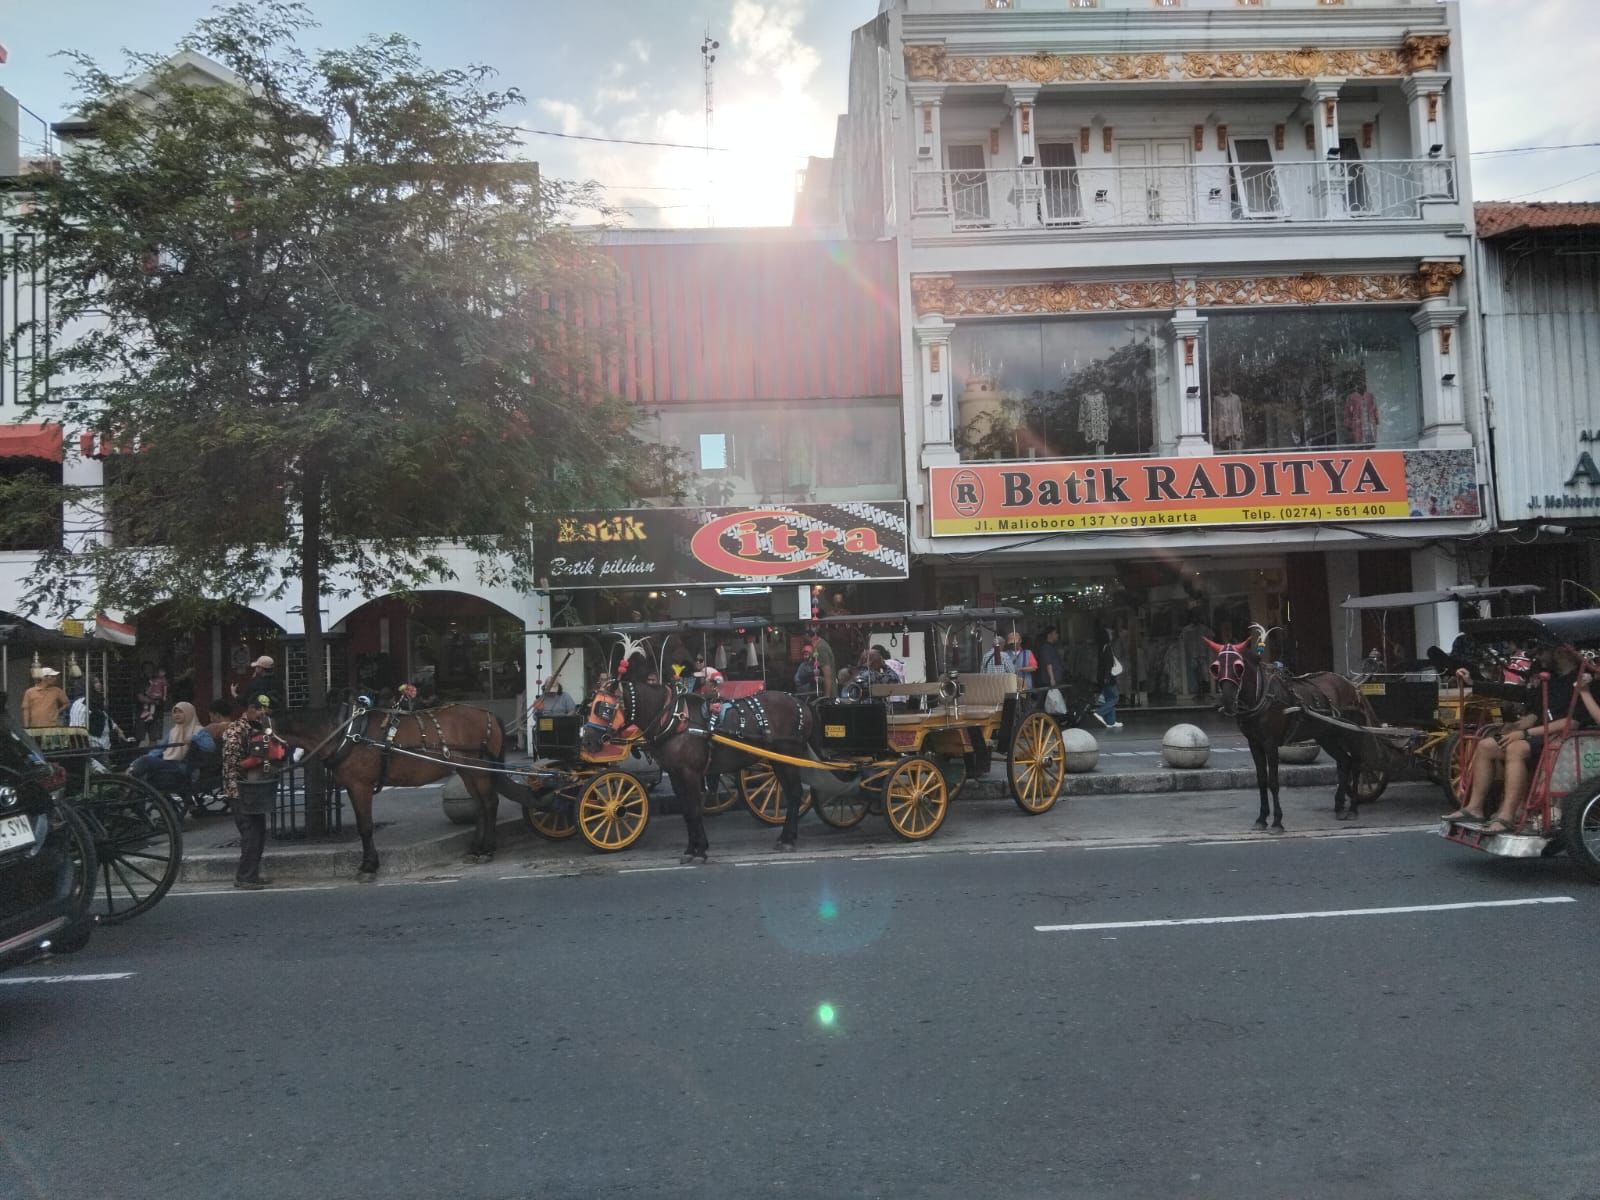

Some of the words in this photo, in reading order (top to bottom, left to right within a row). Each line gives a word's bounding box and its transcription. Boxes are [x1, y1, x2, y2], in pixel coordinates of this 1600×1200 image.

[956, 482, 979, 504] R
[1000, 467, 1132, 508] Batik
[1142, 457, 1390, 501] RADITYA
[974, 520, 993, 532] Jl.
[998, 516, 1075, 530] Malioboro
[1080, 515, 1105, 528] 137
[1110, 511, 1198, 528] Yogyakarta
[1280, 506, 1323, 520] (0274)
[1335, 505, 1358, 518] 561
[1362, 504, 1387, 517] 400
[690, 510, 880, 577] Citra
